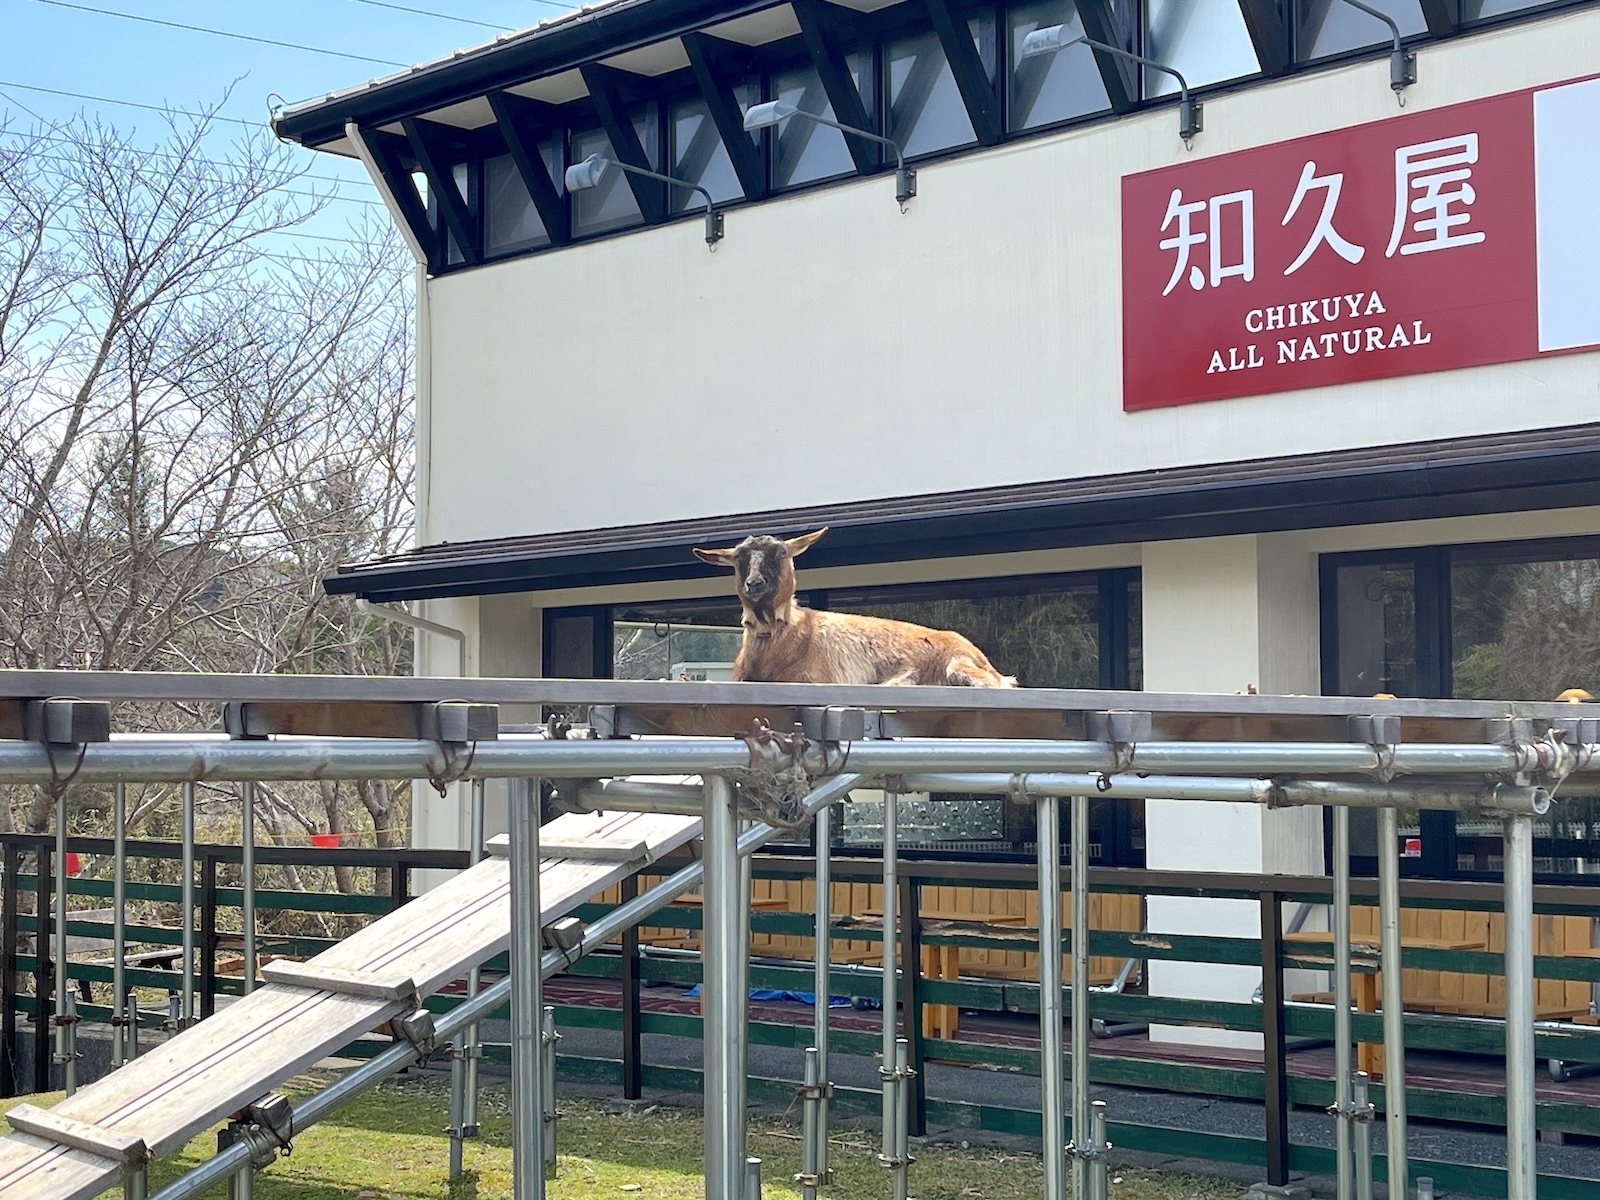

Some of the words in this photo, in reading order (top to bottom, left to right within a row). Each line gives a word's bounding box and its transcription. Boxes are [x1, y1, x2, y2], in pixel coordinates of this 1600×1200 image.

[1159, 132, 1486, 297] 知久屋
[1244, 290, 1387, 334] CHIKUYA
[1206, 344, 1264, 374] ALL
[1276, 320, 1432, 364] NATURAL
